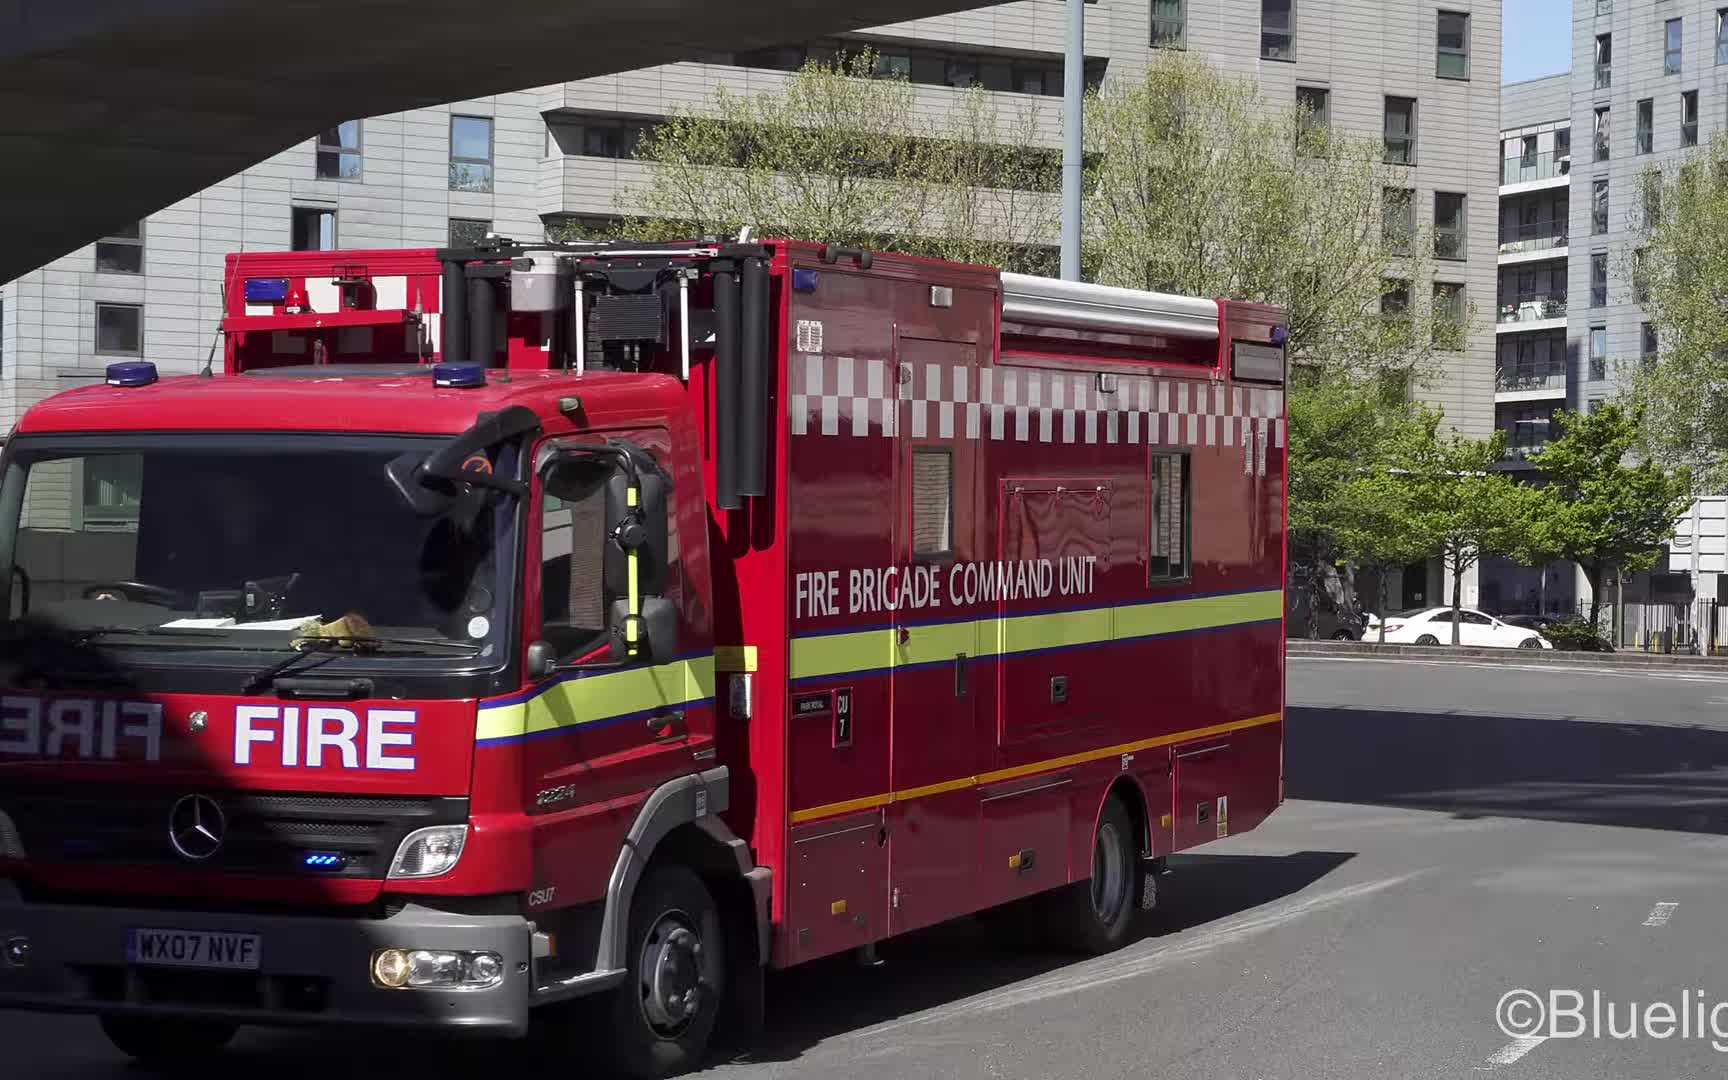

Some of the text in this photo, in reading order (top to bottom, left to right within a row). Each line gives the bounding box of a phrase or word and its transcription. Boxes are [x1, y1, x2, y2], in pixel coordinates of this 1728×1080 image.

[796, 555, 1097, 618] FIRE BRIGADE COMMAND UNIT
[837, 695, 849, 714] CU
[233, 704, 417, 770] FIRE
[839, 718, 845, 737] 7
[140, 934, 255, 963] WX07 NVF
